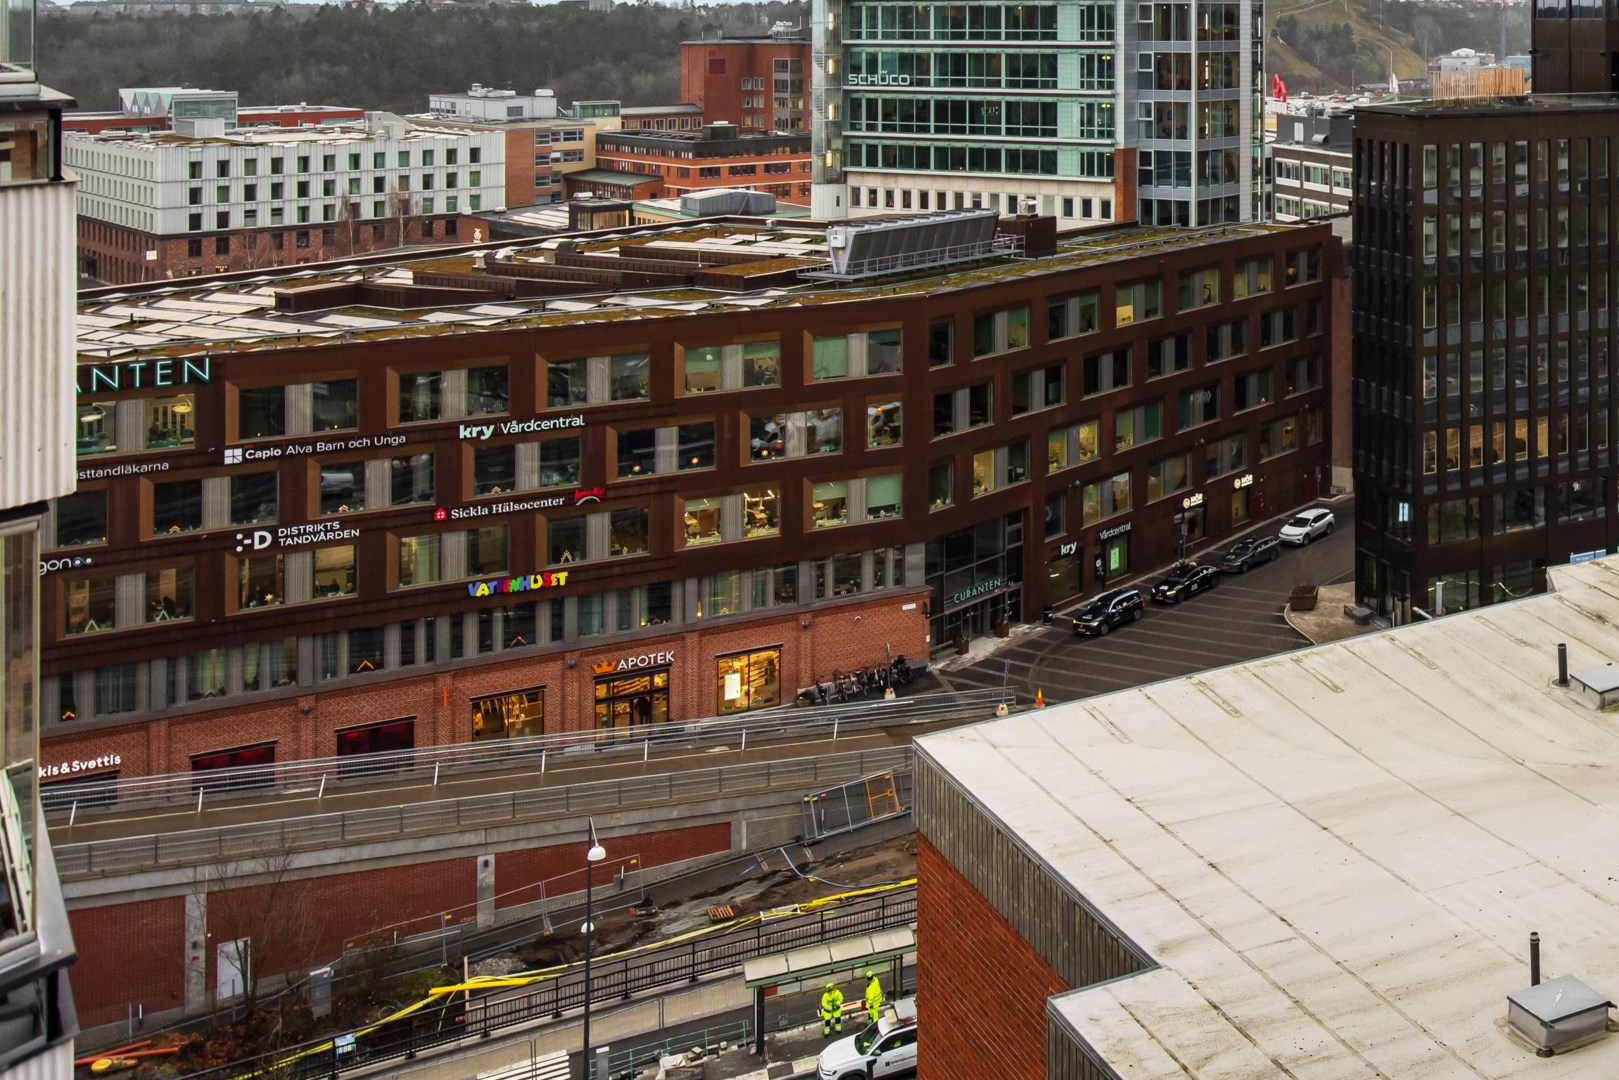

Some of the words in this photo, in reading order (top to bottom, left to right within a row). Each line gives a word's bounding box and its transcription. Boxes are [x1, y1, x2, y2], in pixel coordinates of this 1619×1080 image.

[848, 70, 910, 86] SCHÜCO
[76, 357, 209, 393] NTEN
[459, 424, 495, 440] kry
[500, 414, 585, 434] Vårdcentral
[245, 448, 282, 460] Capio
[286, 445, 313, 456] Alva
[316, 442, 345, 452] Barn
[348, 437, 371, 449] och
[374, 434, 406, 446] Unga
[451, 505, 489, 519] Sickla
[492, 497, 565, 514] Hälsocenter
[278, 521, 340, 537] DISTRIKTS
[278, 529, 360, 547] TANDVÅRDEN
[1099, 521, 1132, 540] Vårdcentral
[1060, 541, 1077, 556] kry
[467, 571, 569, 597] VATTENHUSET
[953, 578, 1001, 603] CURANTEN
[617, 650, 675, 671] APOTEK
